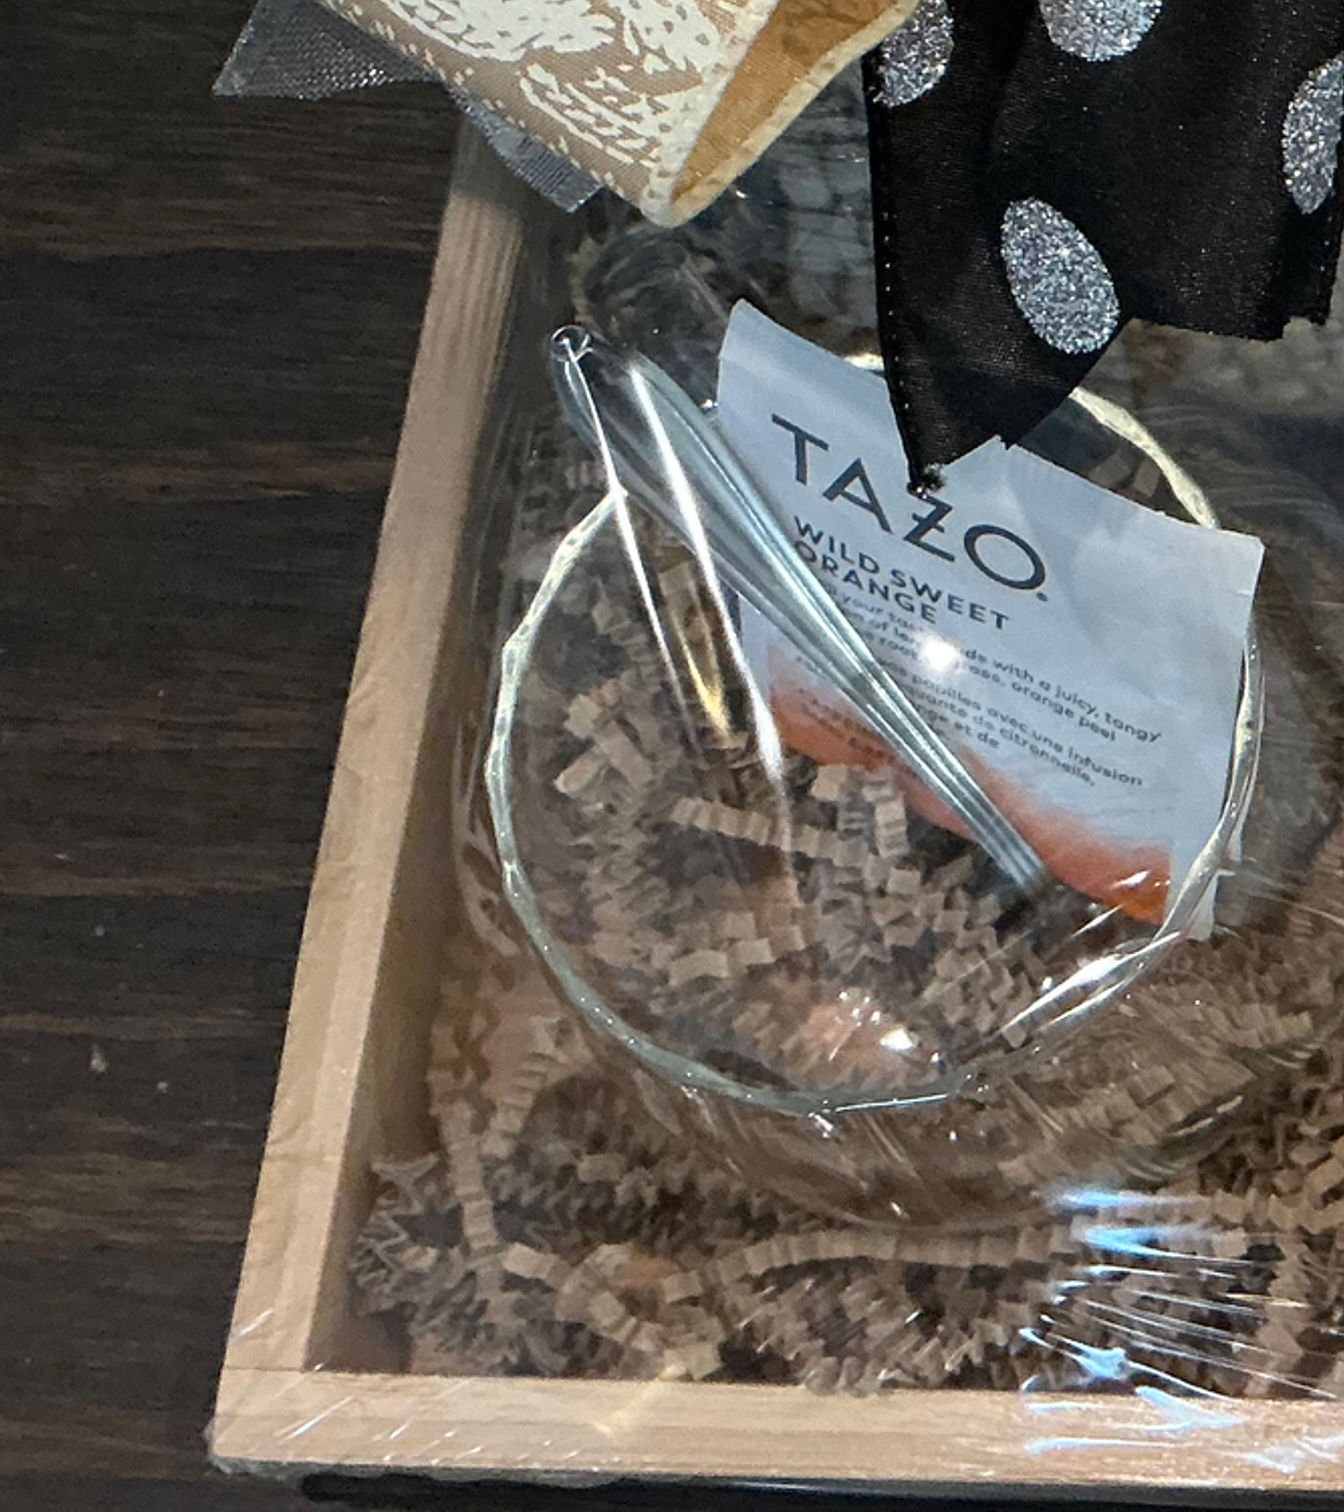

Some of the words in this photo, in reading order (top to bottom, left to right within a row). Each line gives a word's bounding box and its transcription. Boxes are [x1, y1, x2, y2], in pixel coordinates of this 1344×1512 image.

[772, 414, 1046, 591] TAZO
[793, 515, 880, 575] WILD
[890, 568, 1010, 630] SWEET
[793, 540, 938, 625] ORANGE
[992, 658, 1034, 684] with
[1038, 679, 1051, 692] a
[1104, 711, 1162, 744] tangy
[1010, 680, 1075, 719] orange
[1078, 715, 1116, 742] peel
[1067, 745, 1144, 786] infusion
